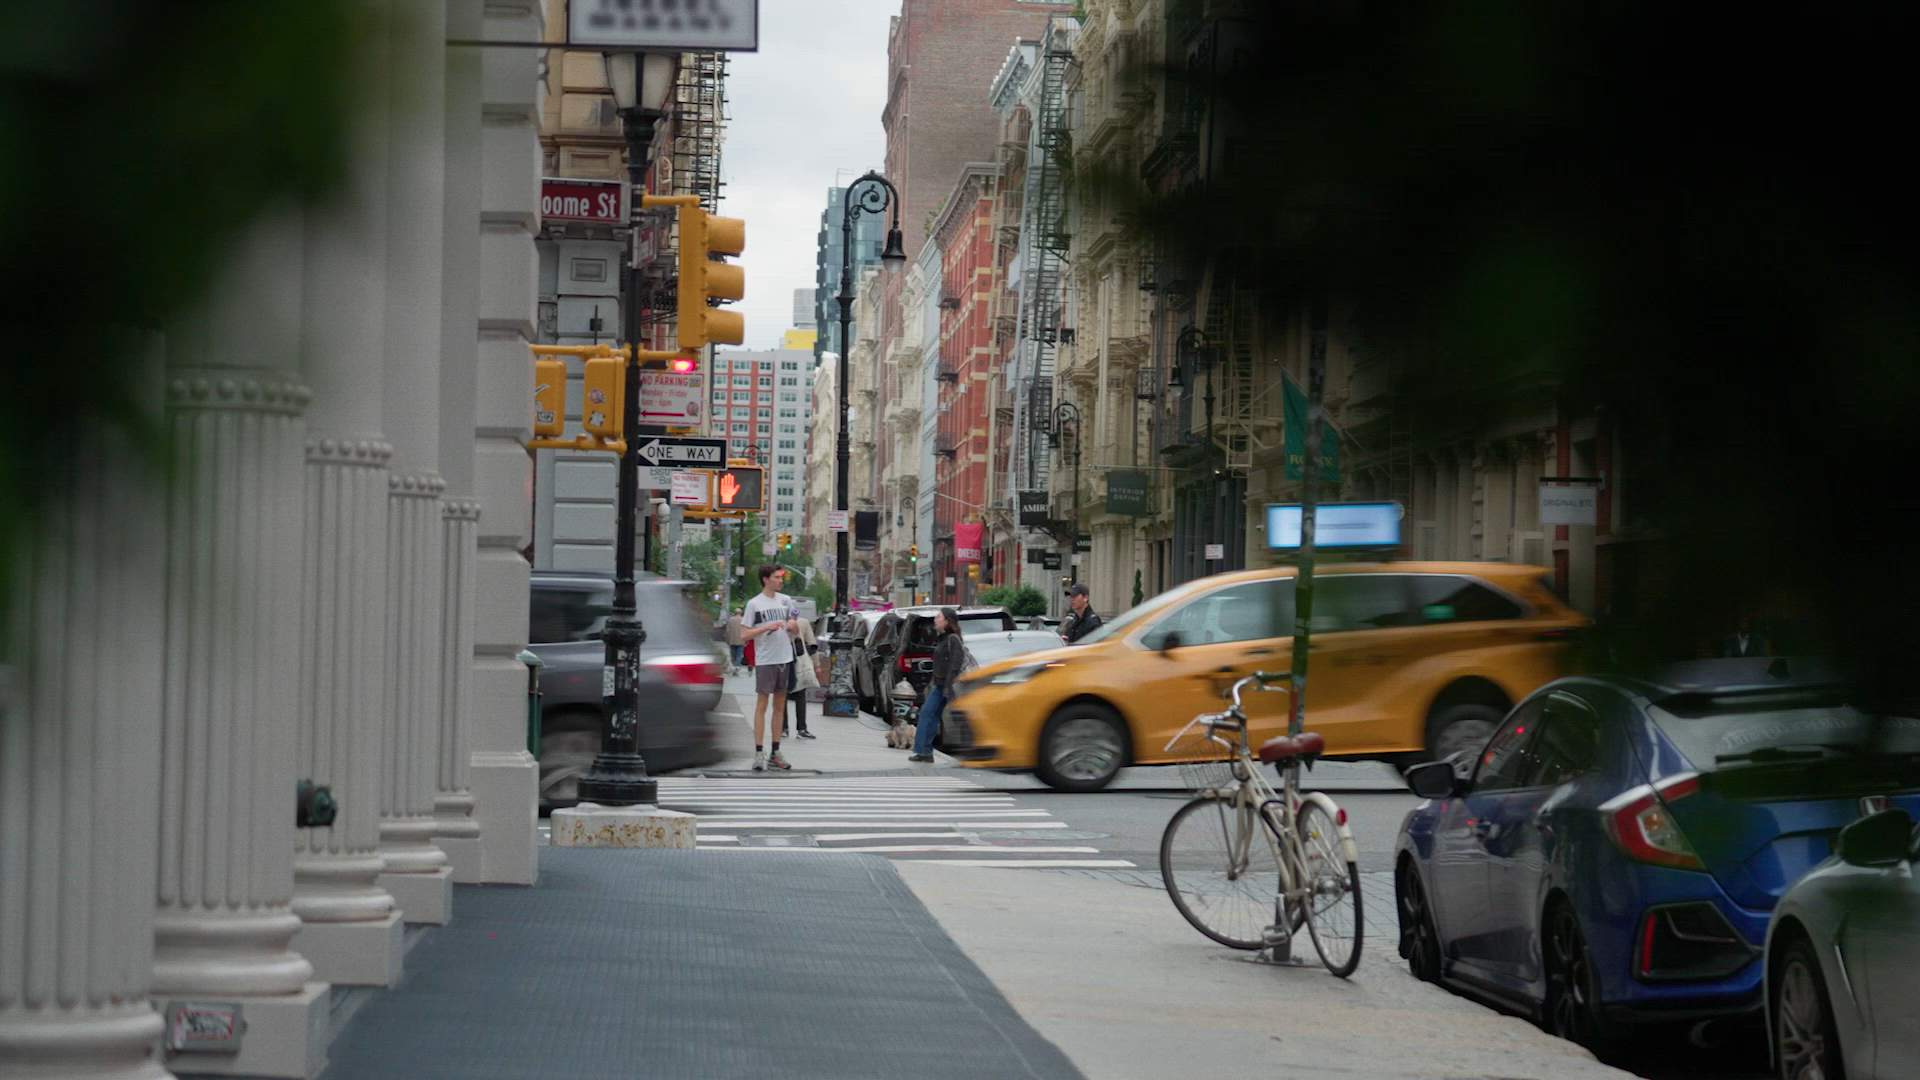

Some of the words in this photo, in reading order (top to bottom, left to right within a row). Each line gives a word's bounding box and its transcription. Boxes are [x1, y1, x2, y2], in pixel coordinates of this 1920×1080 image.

[542, 195, 590, 216] oome
[597, 192, 616, 218] St
[641, 375, 653, 385] NO
[655, 375, 689, 386] PARKING
[647, 446, 673, 459] ONE
[687, 447, 714, 460] WAY
[1022, 503, 1048, 513] AMIR
